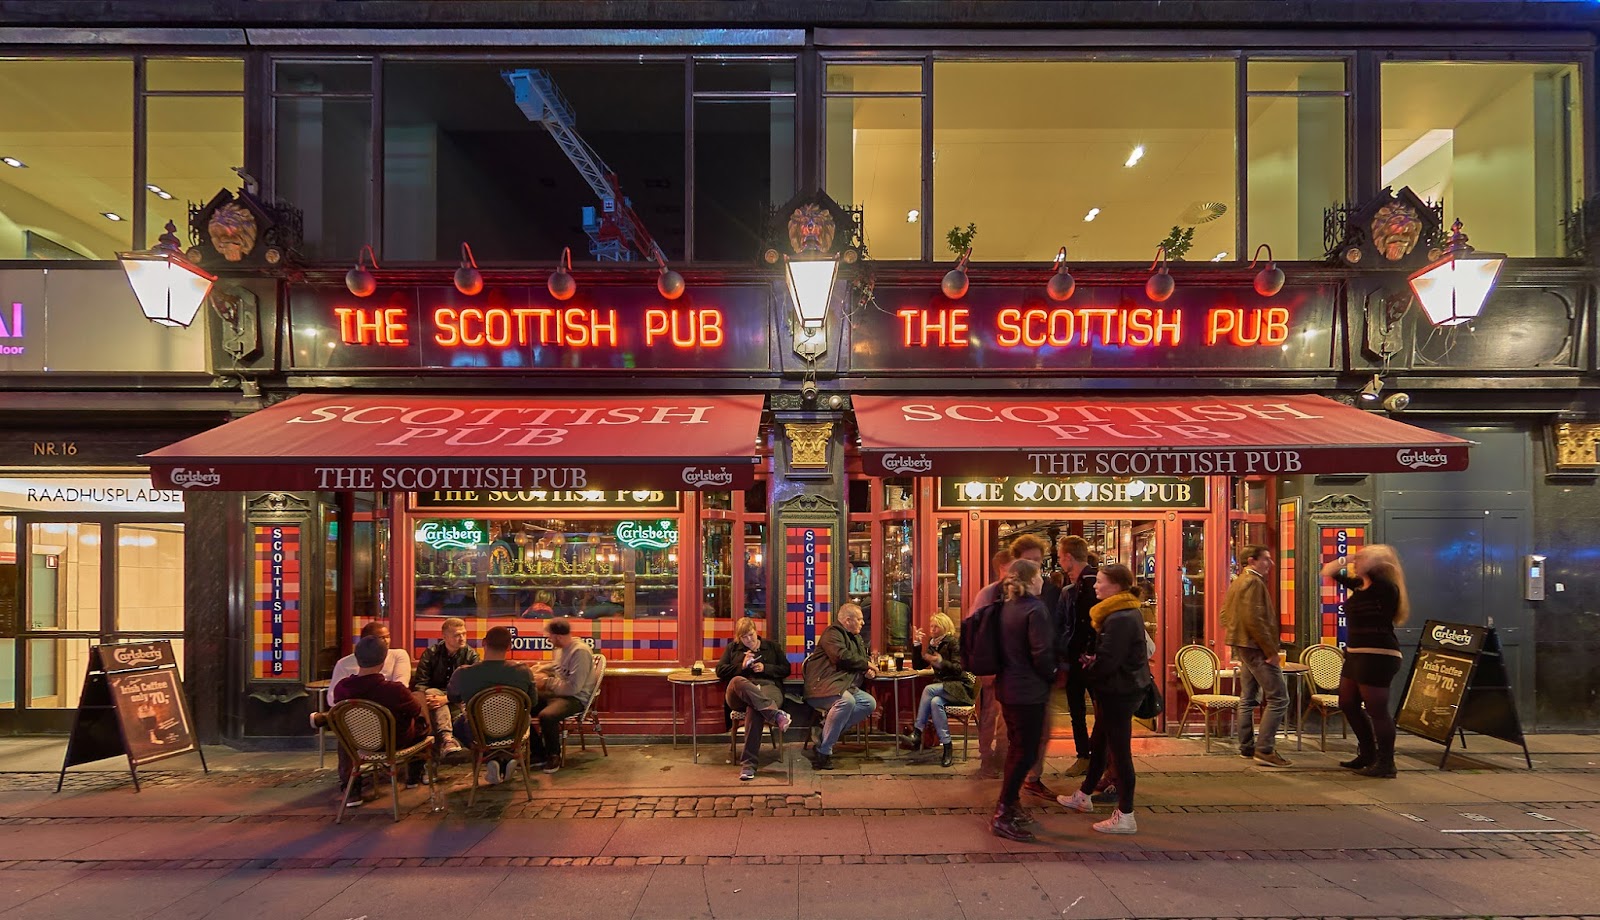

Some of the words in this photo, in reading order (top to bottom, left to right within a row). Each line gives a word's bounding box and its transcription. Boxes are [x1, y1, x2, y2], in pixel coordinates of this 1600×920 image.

[334, 308, 409, 346] THE
[434, 308, 617, 347] SCOTTISH
[645, 309, 724, 347] PUB
[897, 308, 969, 346] THE
[997, 308, 1181, 347] SCOTTISH
[1207, 308, 1291, 346] PUB
[286, 405, 716, 426] SCOTTISH
[900, 403, 1325, 424] SCOTTISH
[375, 427, 570, 447] PUB
[1038, 424, 1232, 440] PUB
[33, 442, 59, 456] NR.
[61, 442, 78, 456] 16
[1396, 449, 1448, 469] Carlsberg
[882, 453, 932, 474] Carlsberg
[1028, 453, 1089, 475] THE
[1095, 452, 1236, 475] SCOTTISH
[1245, 451, 1303, 473] PUB
[171, 468, 221, 488] Carlsberg
[314, 467, 375, 489] THE
[381, 466, 523, 489] SCOTTISH
[530, 467, 588, 488] PUB
[682, 467, 733, 487] Carlsberg
[1014, 483, 1133, 502] SCOTISH
[1142, 483, 1191, 502] PUB
[420, 521, 482, 549] Carlsberg
[616, 520, 678, 548] Carlsberg
[273, 528, 283, 623] SCOTTISH
[805, 531, 815, 626] SCOTTISH
[1431, 624, 1472, 646] Carlsberg
[113, 646, 162, 666] Carlsberg
[274, 638, 283, 672] PUB
[1422, 661, 1440, 673] Irish
[1440, 664, 1464, 678] Coffee
[120, 684, 141, 695] Irish
[141, 681, 169, 692] Coffee
